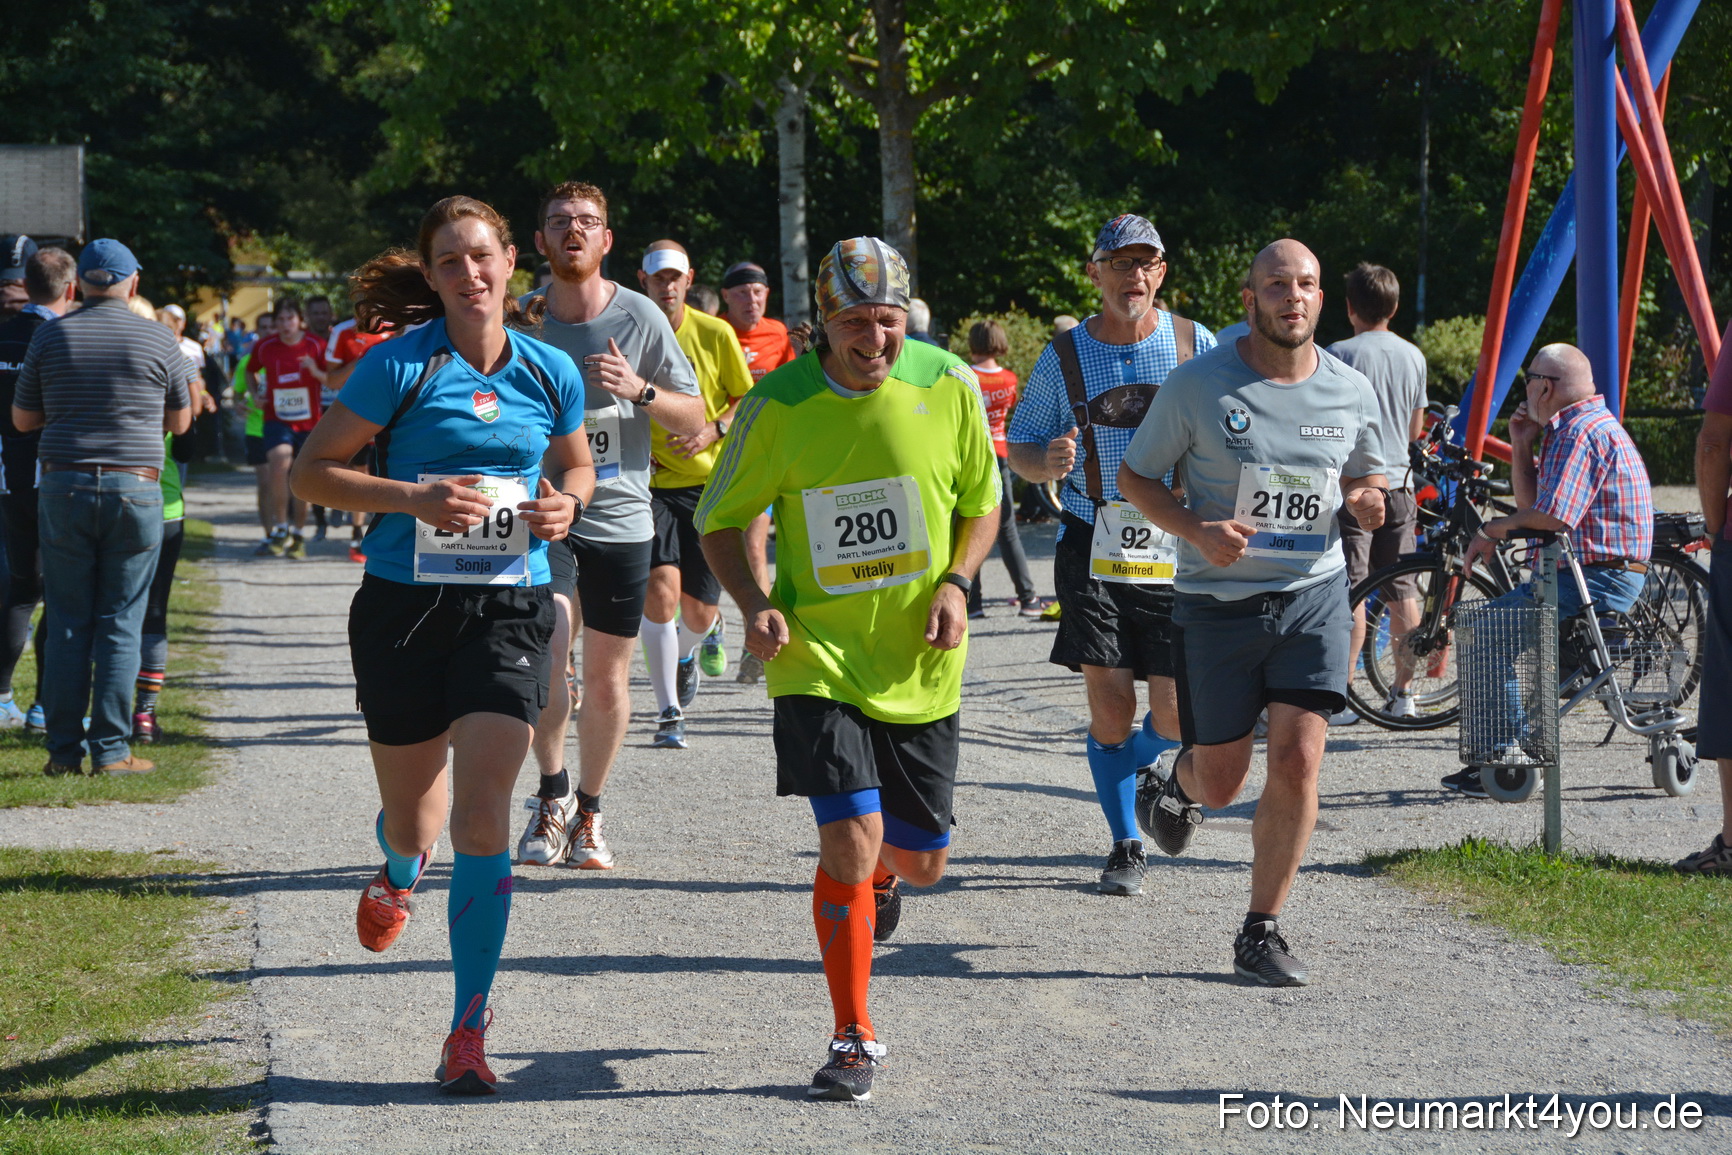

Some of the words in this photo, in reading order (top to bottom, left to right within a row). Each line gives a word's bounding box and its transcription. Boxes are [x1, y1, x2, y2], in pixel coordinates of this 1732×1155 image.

[479, 396, 491, 404] TSV
[1299, 426, 1344, 438] BOCK
[1225, 437, 1253, 445] PARTL
[1269, 473, 1311, 487] BOCK
[835, 488, 887, 507] BOCK
[1250, 490, 1321, 521] 2186
[834, 508, 898, 548] 280
[1277, 523, 1305, 531] Neumarkt
[1121, 526, 1151, 550] 92
[1269, 535, 1295, 551] Jörg
[441, 543, 465, 551] PARTL
[837, 552, 861, 560] PARTL
[862, 545, 895, 557] Neumarkt
[1108, 551, 1126, 559] PARTL
[455, 557, 491, 575] Sonja
[851, 561, 895, 579] Vitaliy
[1112, 563, 1153, 575] Manfred
